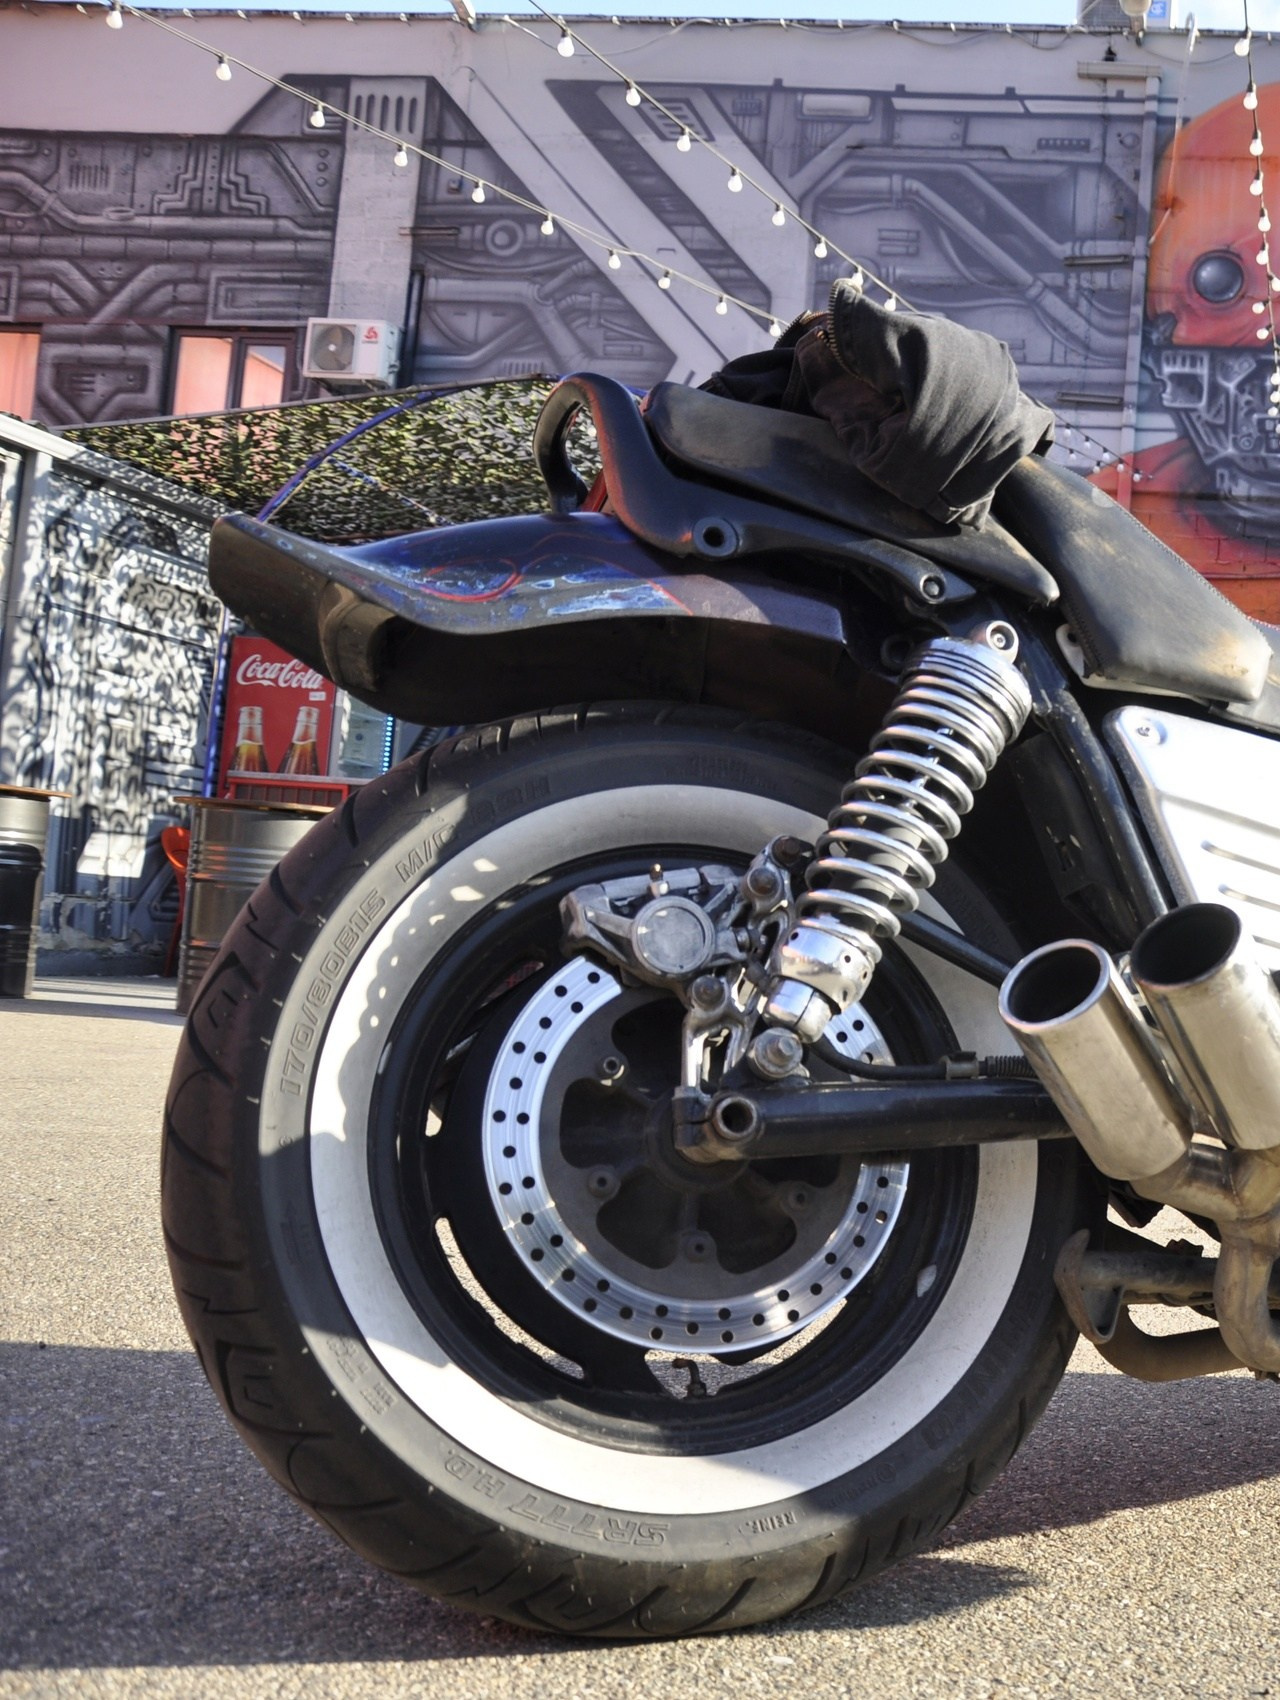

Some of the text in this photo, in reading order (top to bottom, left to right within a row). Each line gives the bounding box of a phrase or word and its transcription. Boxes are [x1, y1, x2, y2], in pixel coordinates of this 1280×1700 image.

[236, 654, 323, 689] Coca-Cola
[281, 887, 386, 1096] 170/80B15
[395, 824, 460, 884] M/C
[445, 1449, 669, 1547] SR777 H.D.
